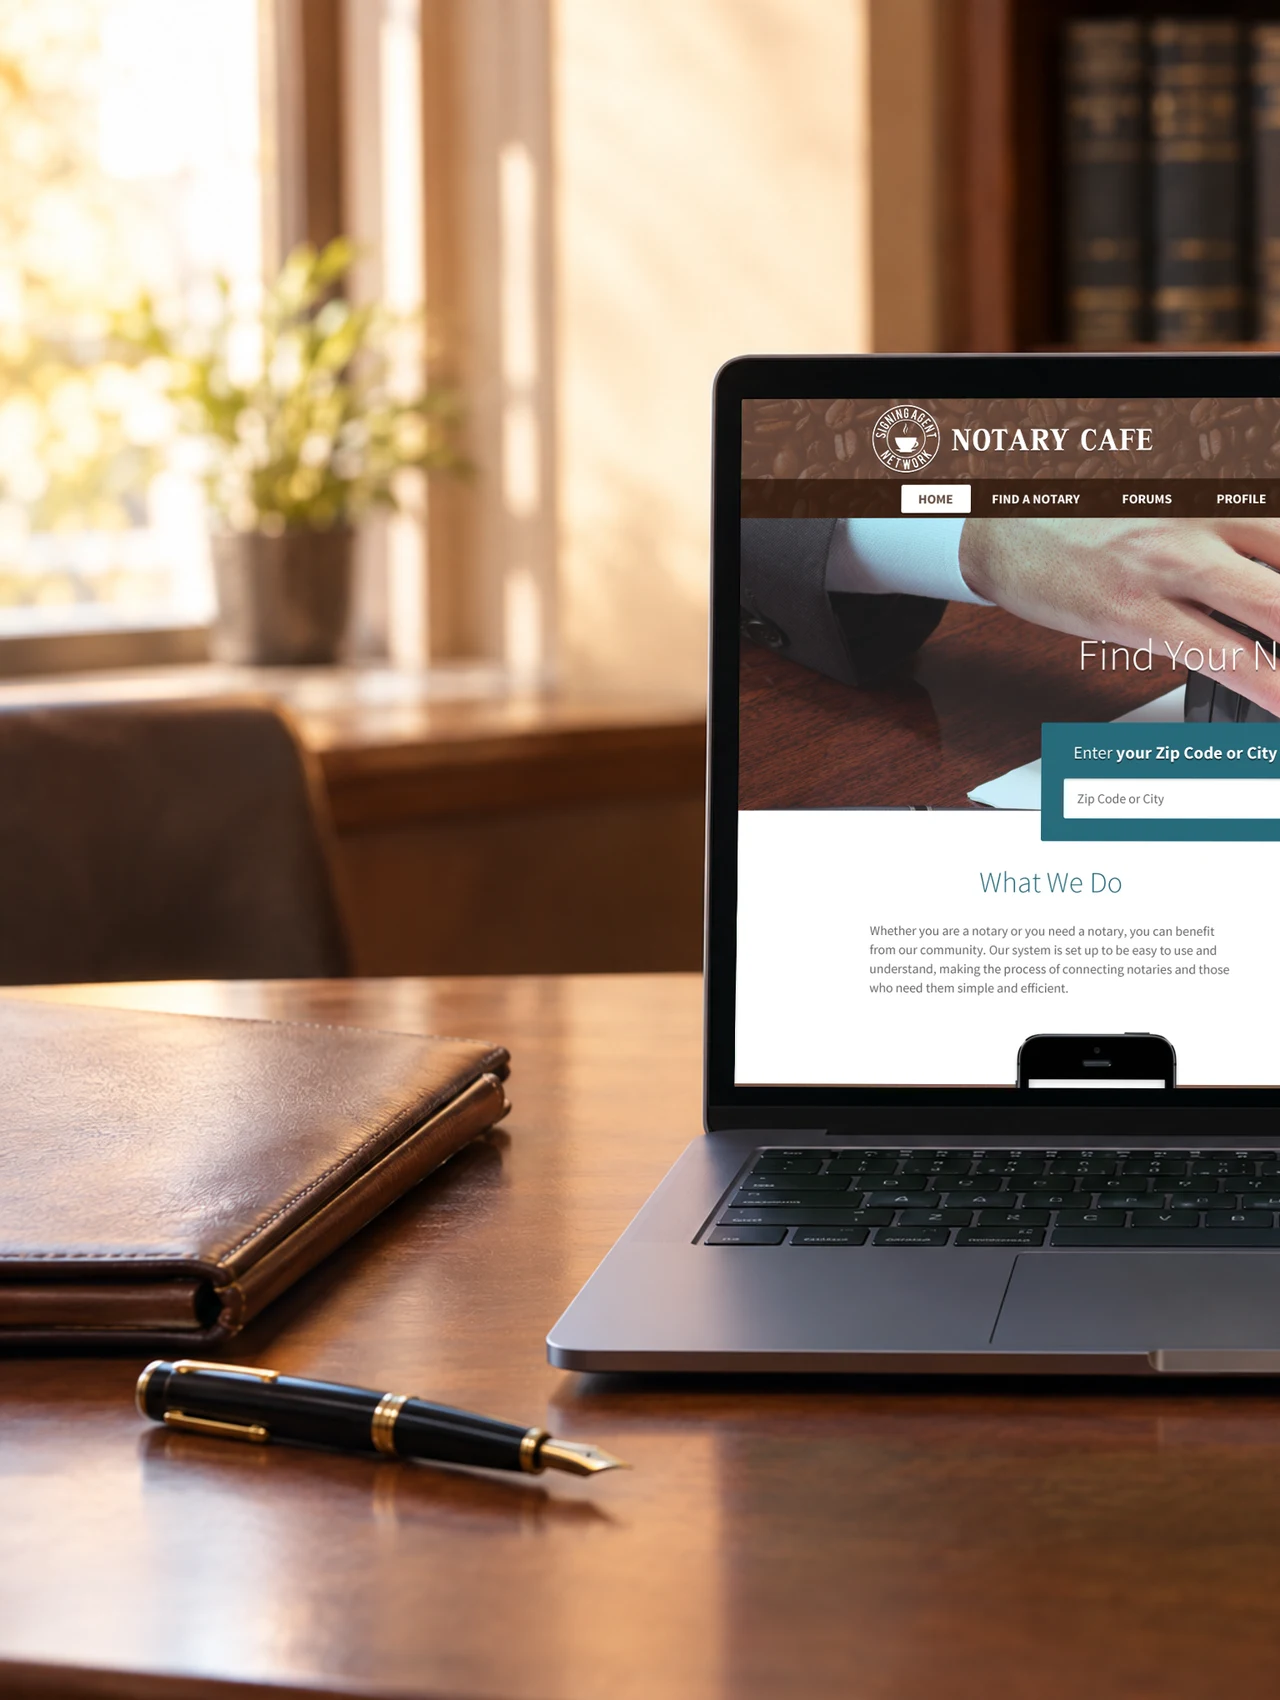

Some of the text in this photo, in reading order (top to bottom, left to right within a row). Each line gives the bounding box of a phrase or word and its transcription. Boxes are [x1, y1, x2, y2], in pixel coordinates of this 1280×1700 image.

[876, 408, 937, 439] SIGNING AGENT
[952, 429, 1152, 451] NOTARY CAFE
[880, 449, 932, 470] NETWORK
[918, 494, 954, 505] HOME
[991, 494, 1081, 505] FIND A NOTARY
[1122, 493, 1173, 505] FORUMS
[1216, 493, 1267, 505] PROFILE
[1080, 637, 1152, 672] Find
[1164, 640, 1244, 672] Your
[1075, 747, 1113, 760] Enter
[1116, 750, 1152, 763] your
[1156, 746, 1179, 762] Zip
[1184, 746, 1222, 759] Code
[1226, 749, 1244, 760] or
[1247, 746, 1277, 762] City
[1076, 792, 1165, 807] Zip Code or City
[980, 871, 1121, 893] What We Do
[869, 925, 1215, 940] Whether you are a notary or you need a notary, you can benefit
[869, 943, 1217, 959] from our community. Our system is set up to be easy to use and
[870, 963, 1230, 977] understand, making the process of connecting notaries and those
[869, 981, 1069, 996] who need them simple and efficient.
